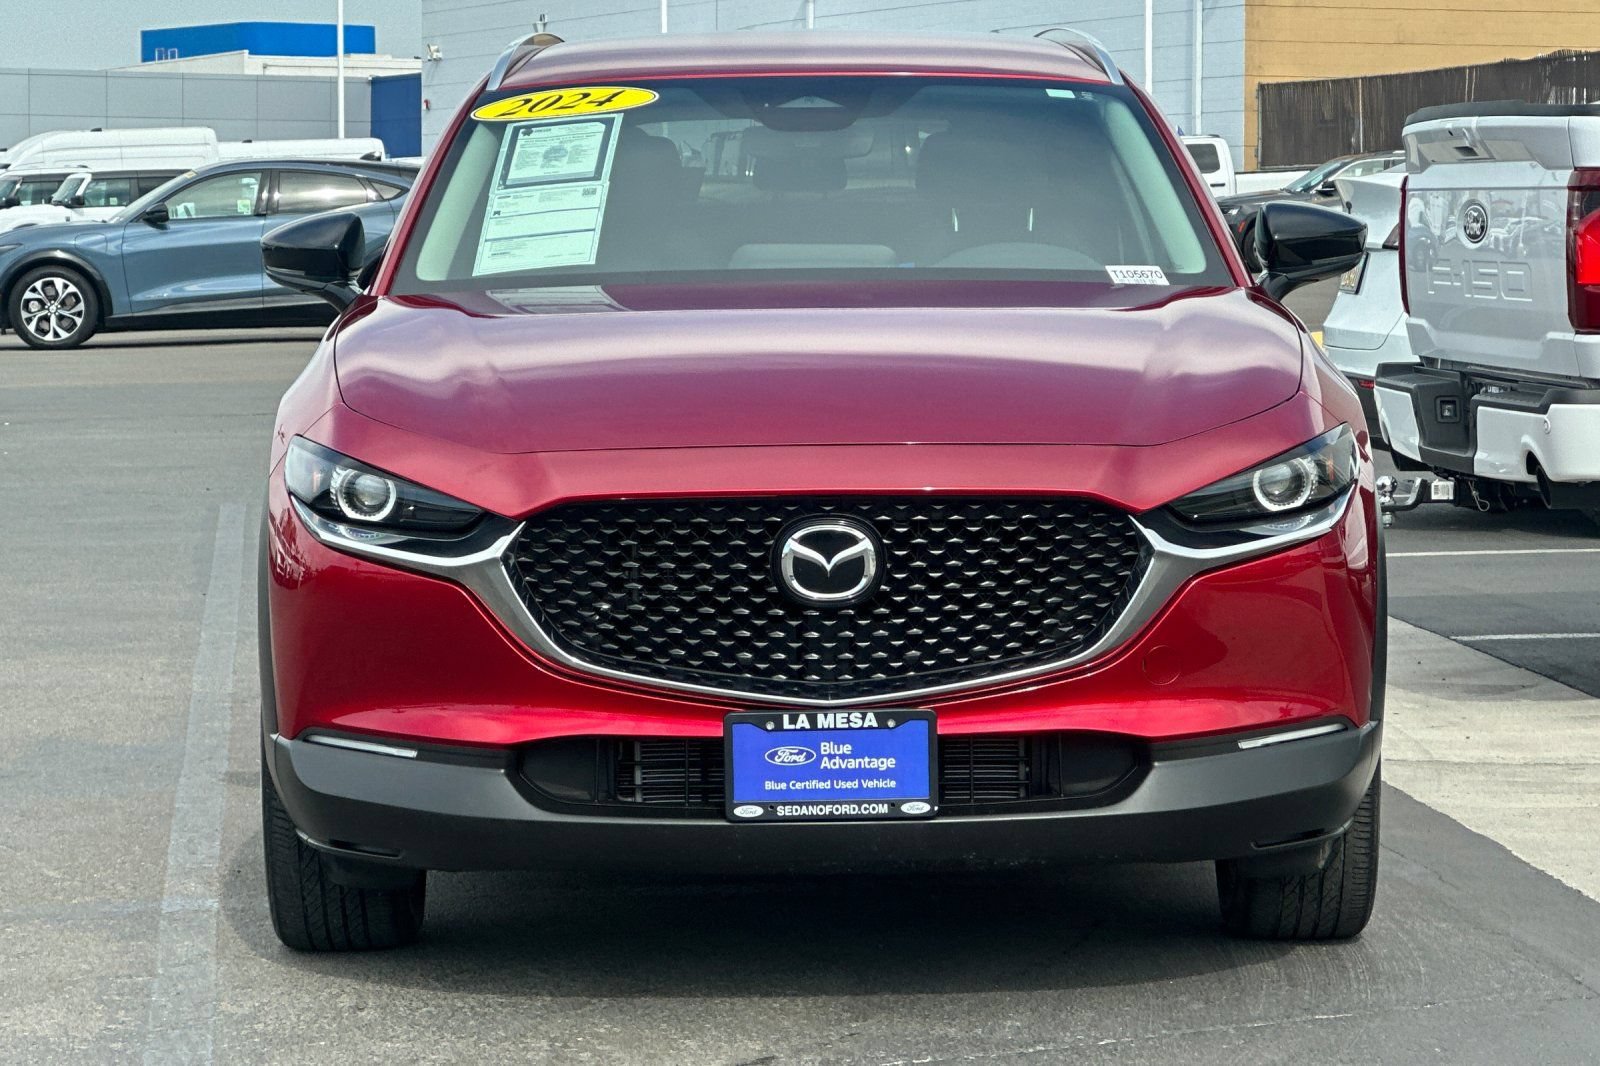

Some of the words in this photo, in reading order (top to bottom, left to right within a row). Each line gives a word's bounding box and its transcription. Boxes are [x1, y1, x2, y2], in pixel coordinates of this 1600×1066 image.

[494, 89, 625, 117] 2024
[1111, 270, 1163, 279] T105670
[1426, 259, 1533, 301] F-150
[783, 714, 810, 729] LA
[817, 713, 878, 728] MESA
[774, 748, 806, 763] Ford
[820, 742, 852, 755] Blue
[820, 756, 896, 771] Advantage
[765, 781, 787, 790] Blue
[789, 780, 831, 790] Certified
[834, 780, 859, 789] Used
[861, 779, 896, 789] Vehicle
[777, 803, 889, 816] SEDANOFORD.COM
